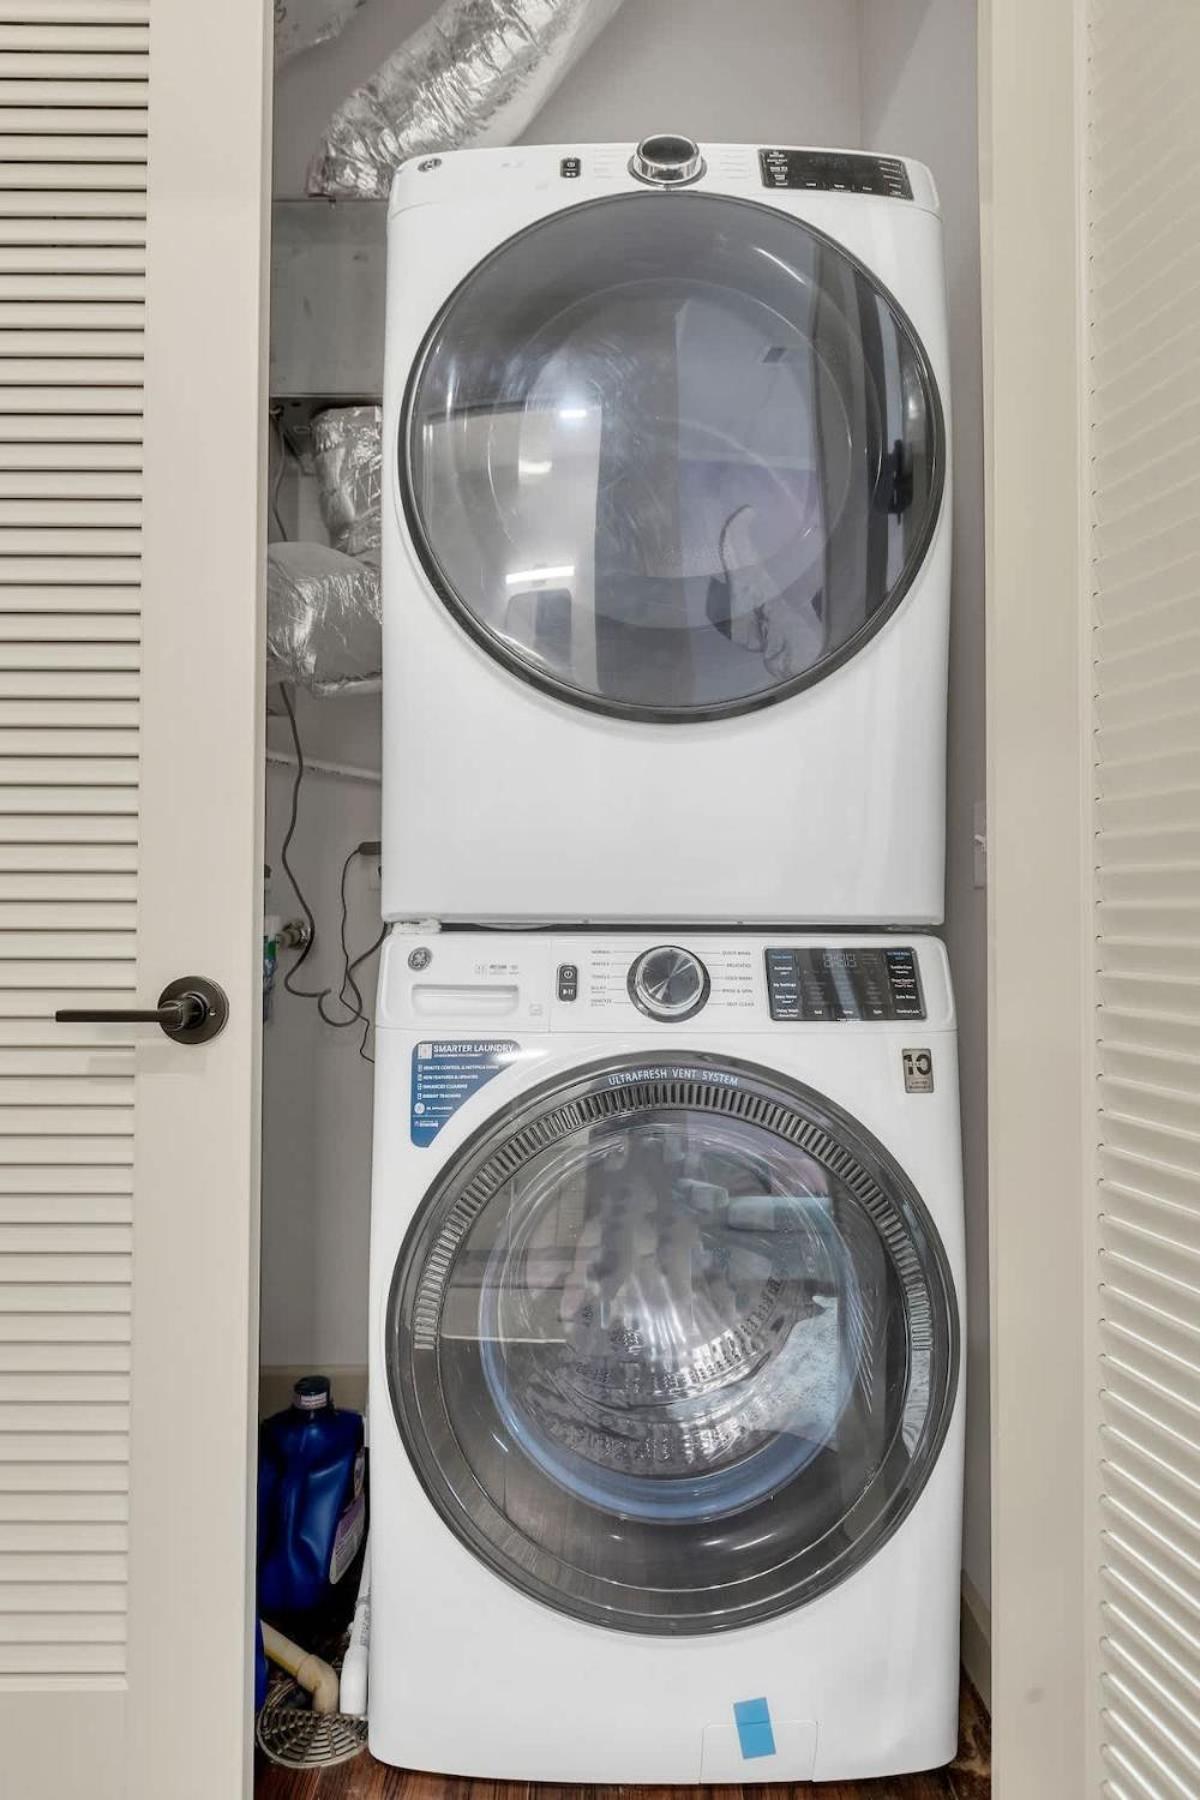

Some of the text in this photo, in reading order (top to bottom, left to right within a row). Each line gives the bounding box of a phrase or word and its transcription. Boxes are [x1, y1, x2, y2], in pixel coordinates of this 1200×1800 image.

[433, 1044, 514, 1053] SMARTER LAUNDRY
[608, 1068, 739, 1087] ULTRAFRESH VENT SYSTEM
